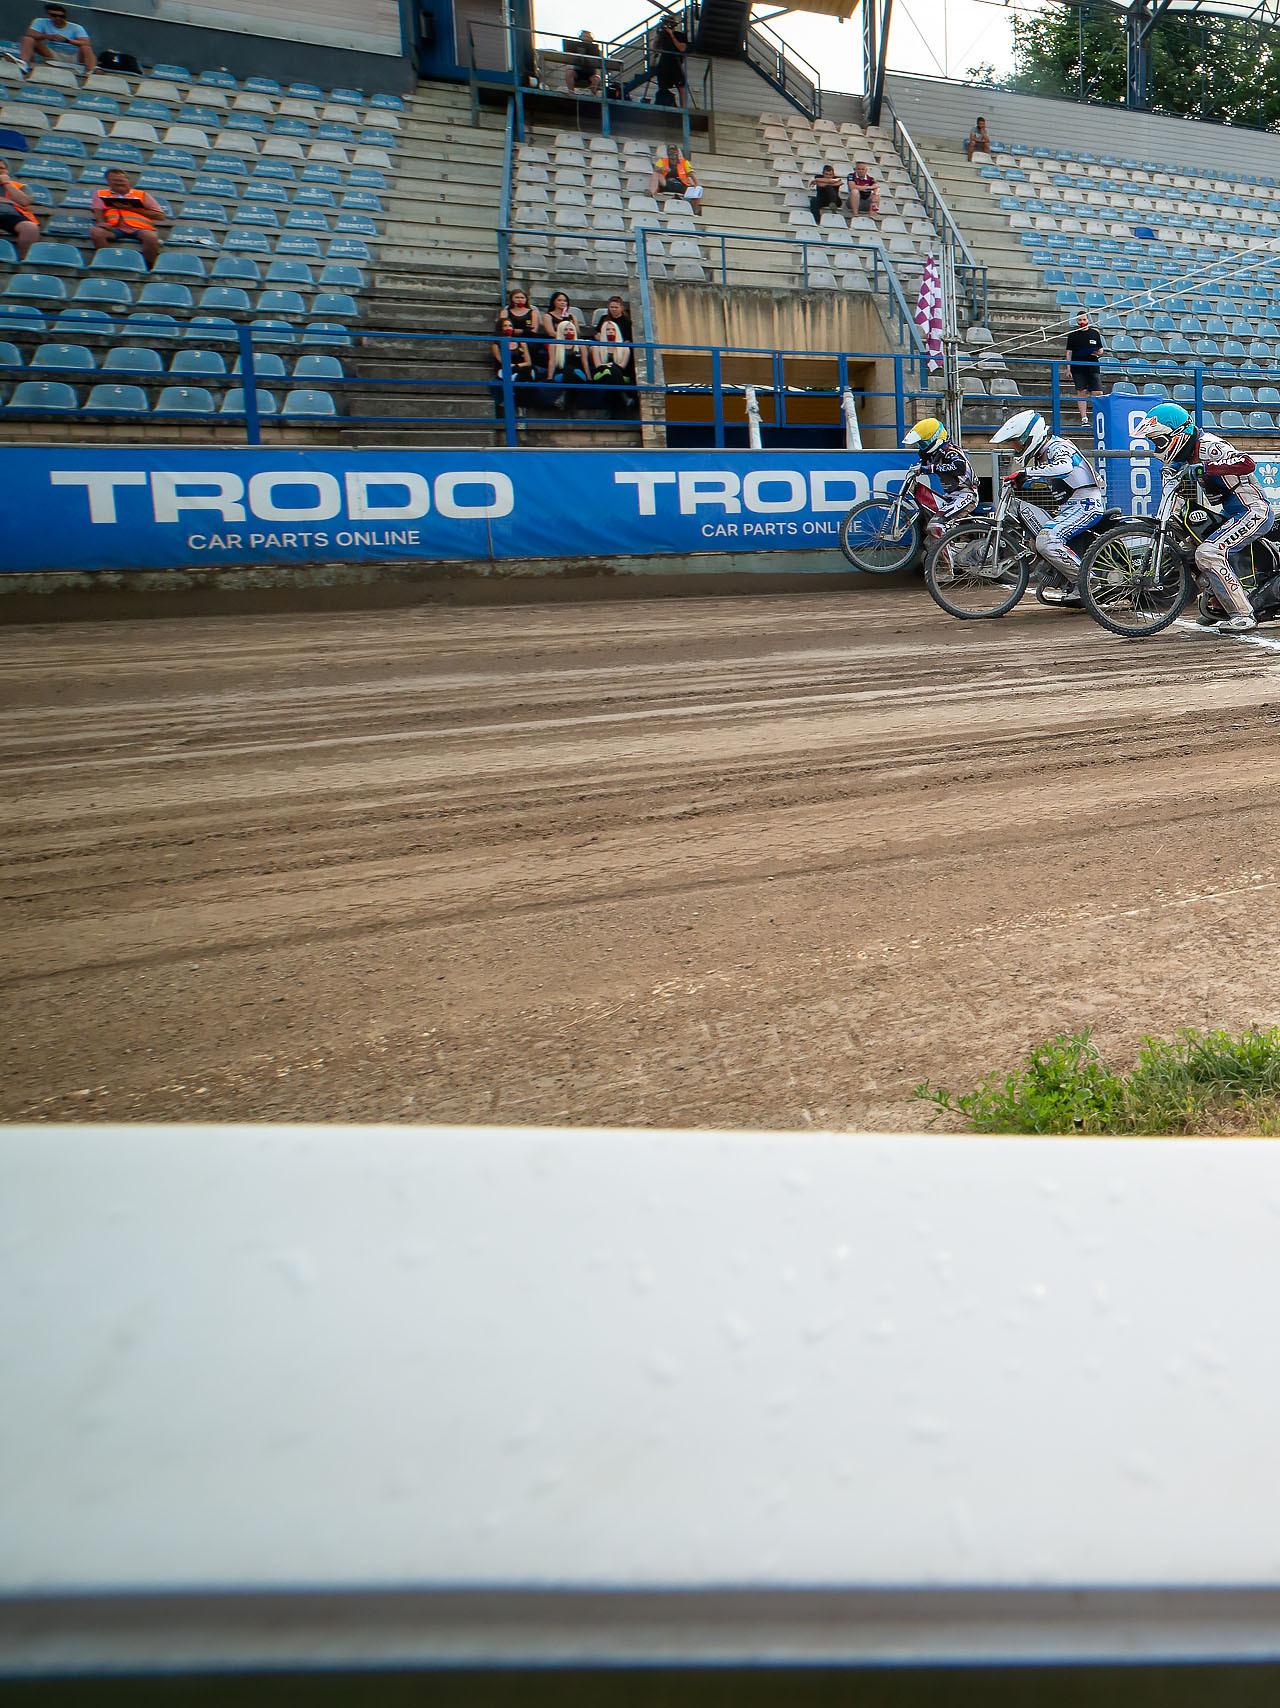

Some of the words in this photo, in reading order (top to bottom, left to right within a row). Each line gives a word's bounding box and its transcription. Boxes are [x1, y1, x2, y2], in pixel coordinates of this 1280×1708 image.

[49, 470, 515, 524] TRODO
[188, 533, 242, 550] CAR
[250, 532, 329, 548] PARTS
[336, 530, 421, 547] ONLINE
[701, 524, 739, 537] CAR
[744, 522, 798, 536] PARTS
[1223, 514, 1261, 546] TUBEX
